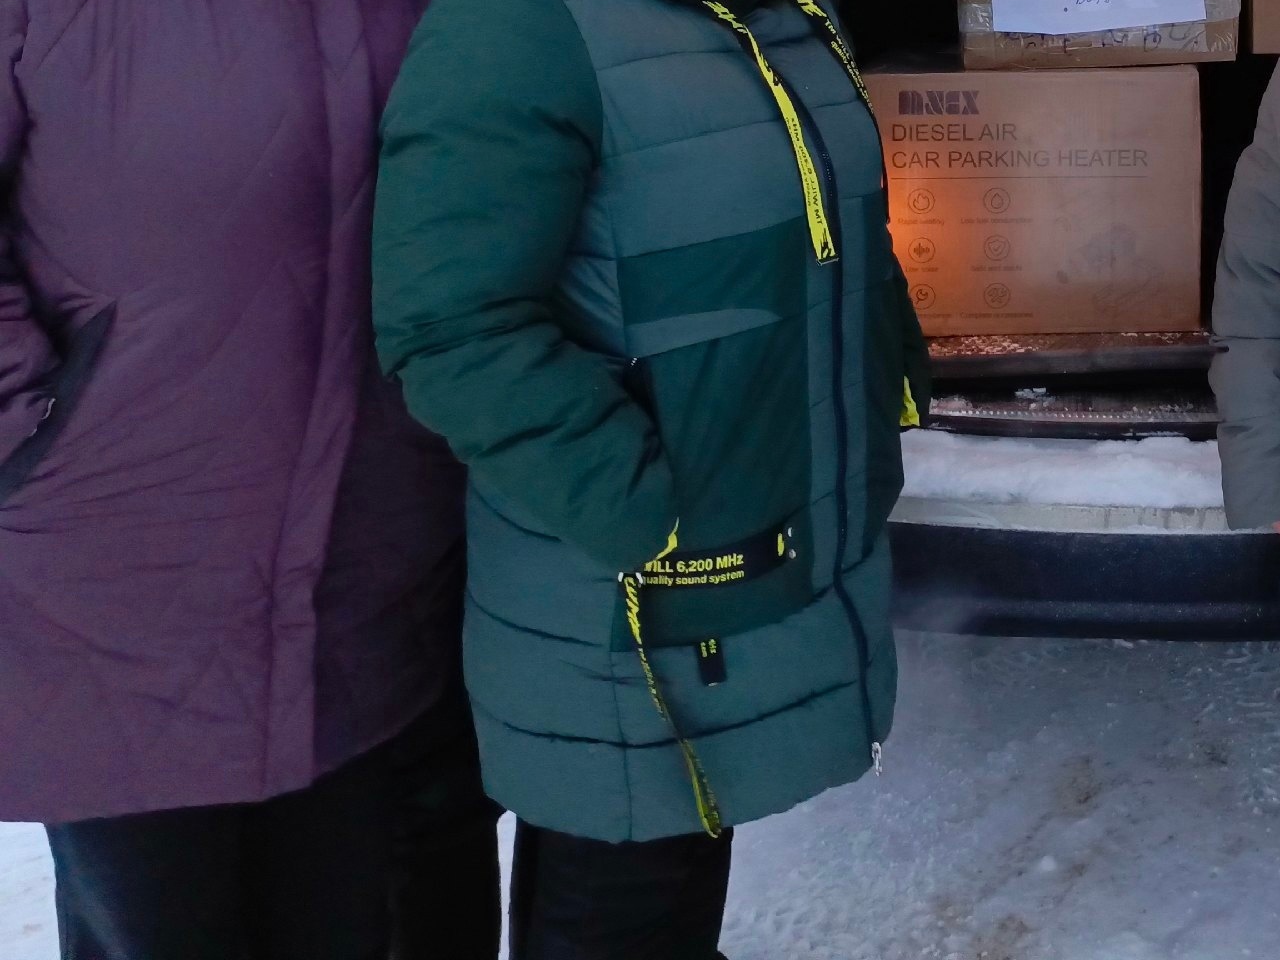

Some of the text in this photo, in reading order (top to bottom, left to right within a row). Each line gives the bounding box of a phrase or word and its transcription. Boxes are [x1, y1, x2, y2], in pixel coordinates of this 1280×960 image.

[891, 123, 1018, 142] DIESEL AIR
[891, 148, 1149, 169] CAR PARKING HEATER
[676, 558, 713, 574] 6,200
[715, 553, 744, 570] MHz
[675, 573, 707, 586] sound
[708, 569, 745, 585] system
